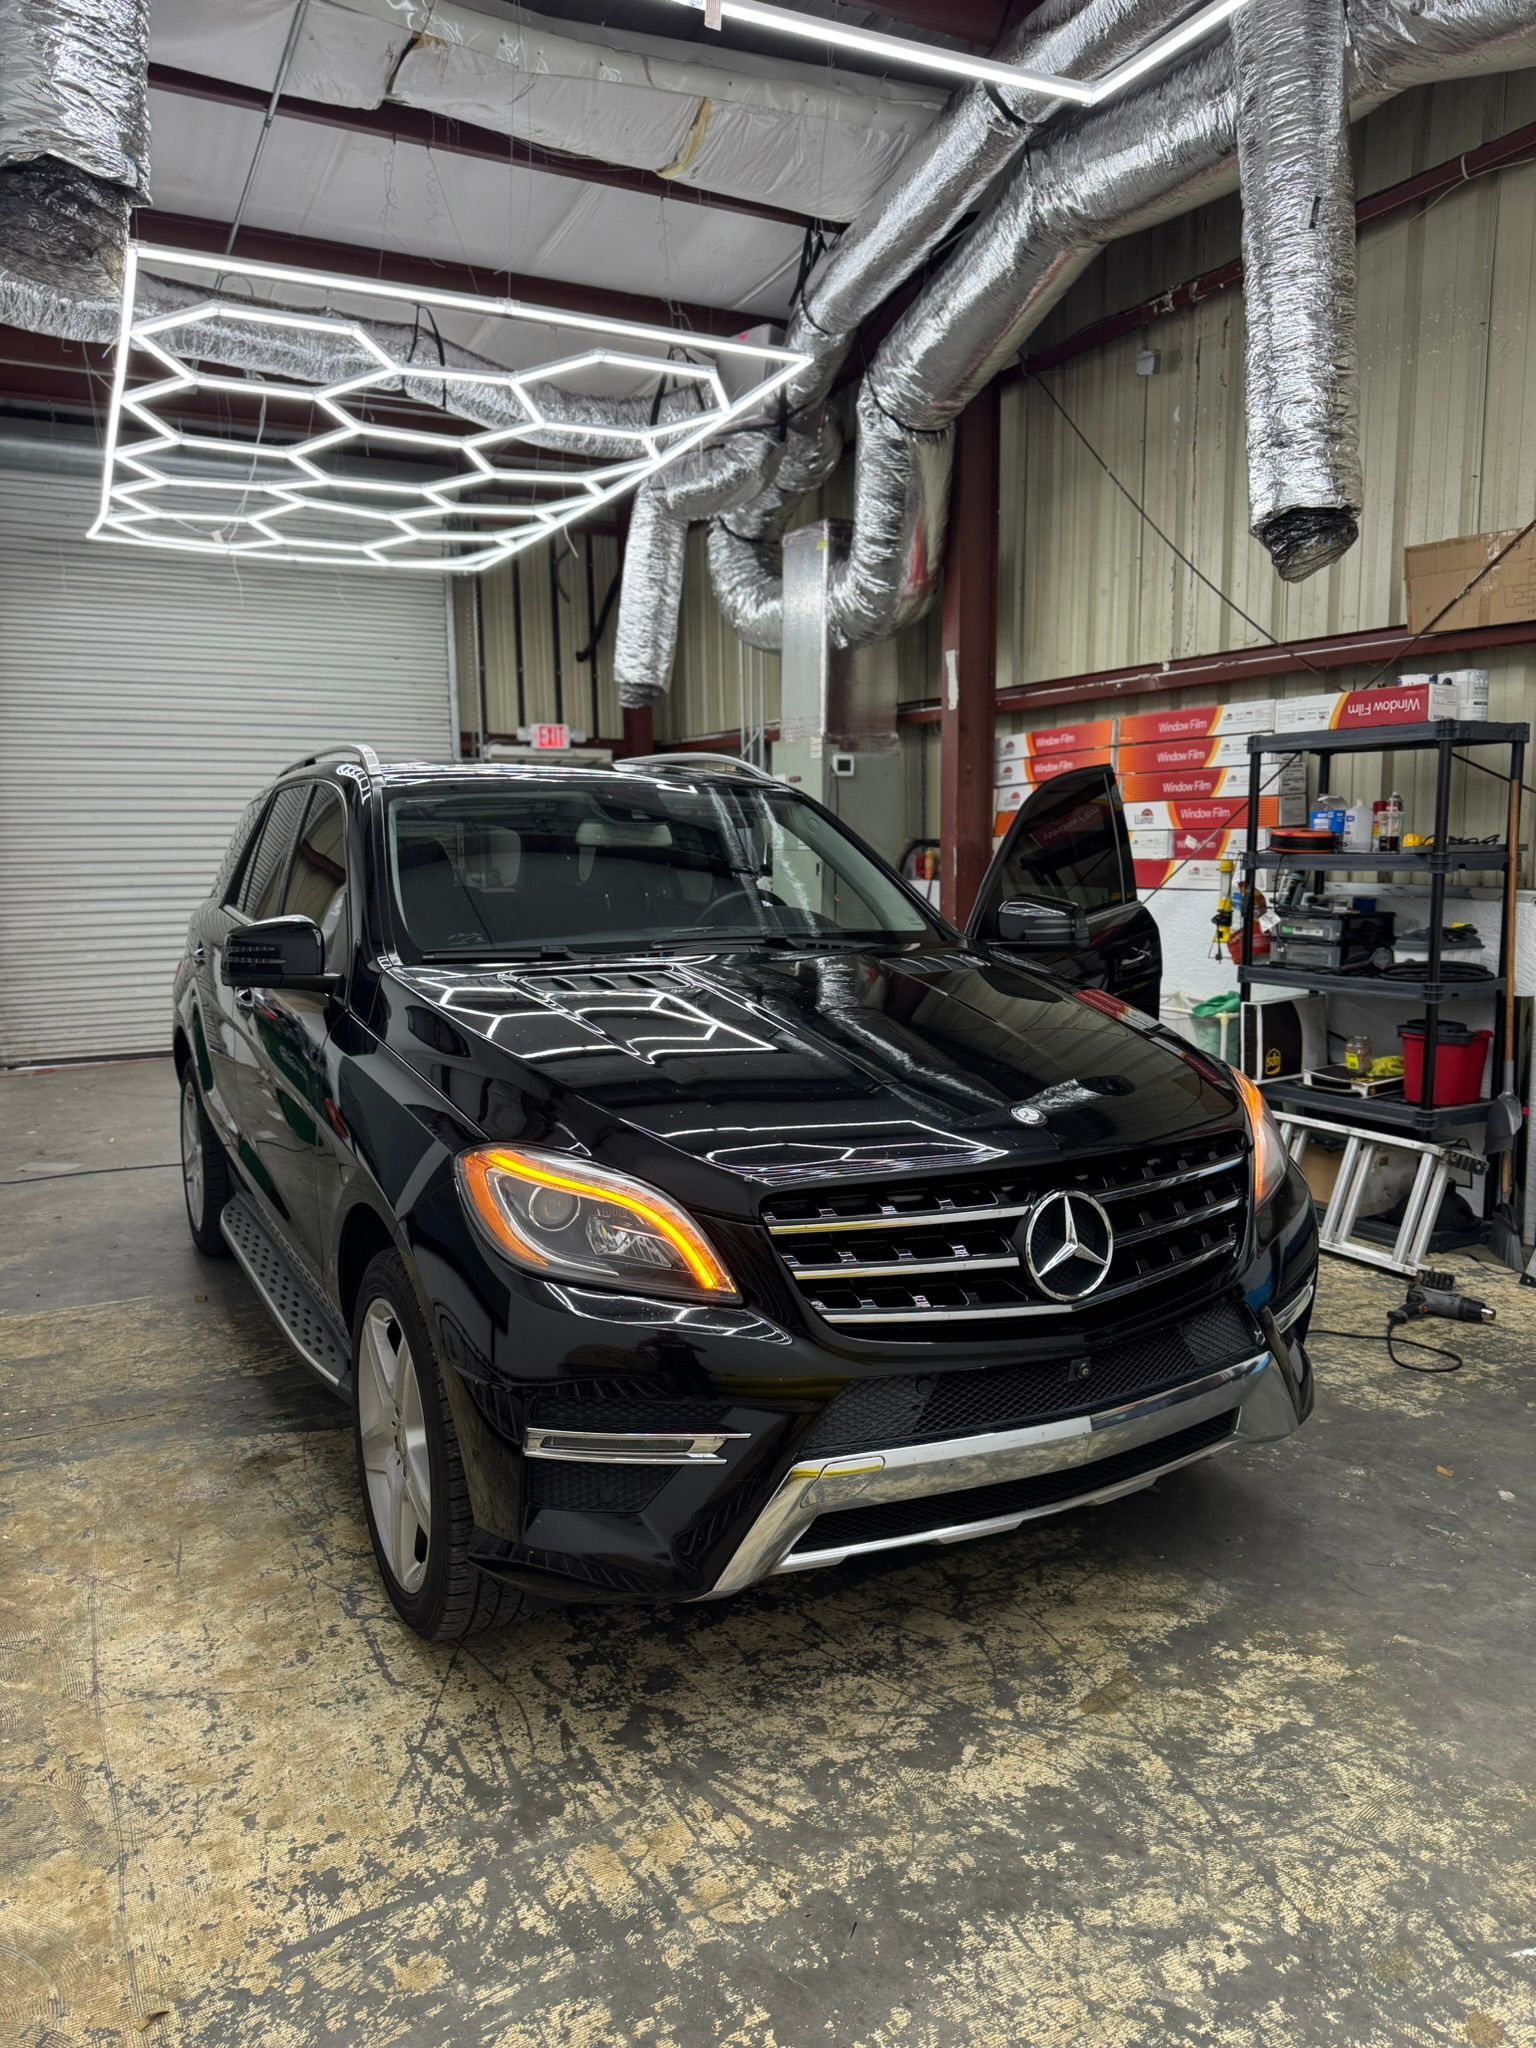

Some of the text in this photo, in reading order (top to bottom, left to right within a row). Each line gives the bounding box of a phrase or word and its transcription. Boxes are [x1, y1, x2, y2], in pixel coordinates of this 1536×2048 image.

[1347, 697, 1420, 717] Window Film
[1158, 718, 1208, 733] Window Film
[538, 725, 565, 747] EXIT
[1035, 733, 1075, 748] Window Film
[1156, 748, 1205, 763] Window Film
[1033, 760, 1073, 774] Window Film
[1162, 779, 1212, 793] Window Film
[1180, 806, 1231, 819] Window Film
